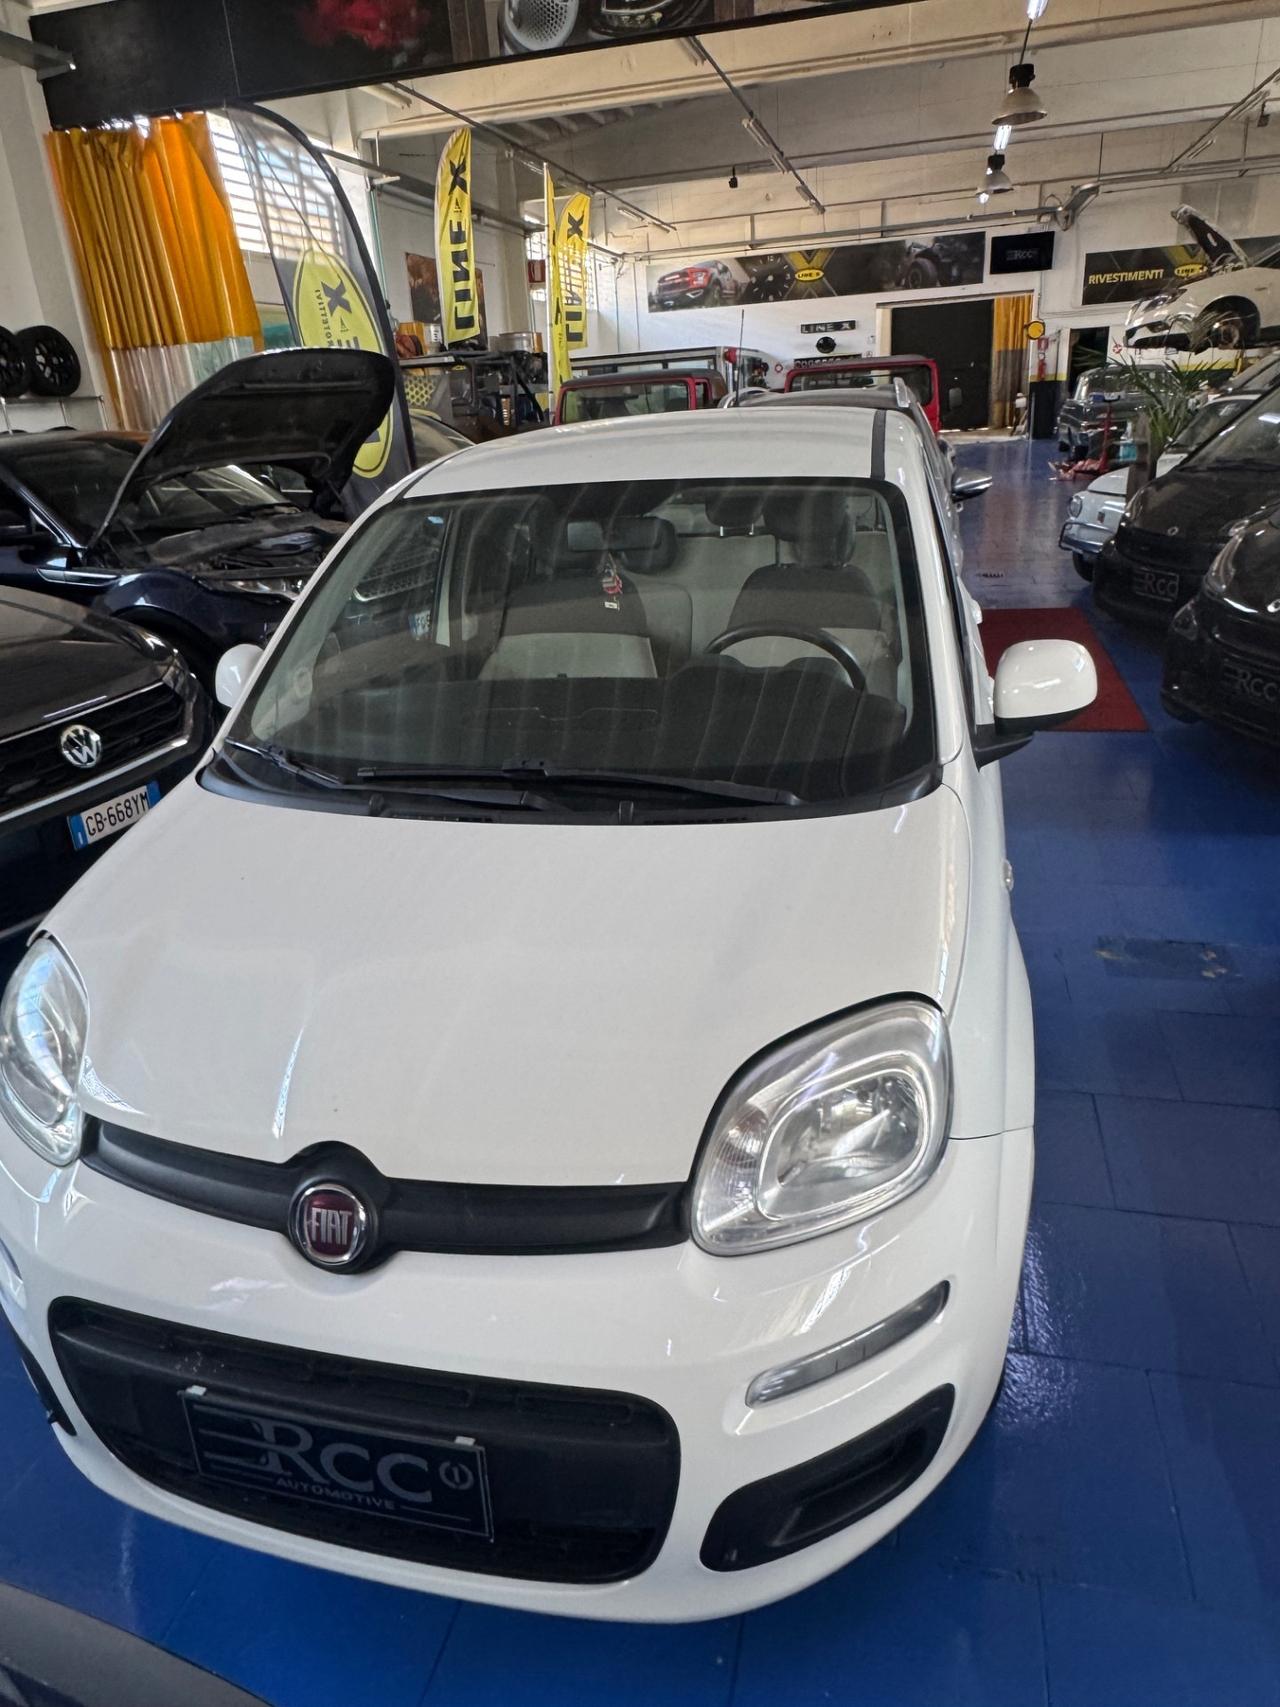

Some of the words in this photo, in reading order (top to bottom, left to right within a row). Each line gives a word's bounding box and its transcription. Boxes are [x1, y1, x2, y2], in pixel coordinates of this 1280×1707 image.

[1088, 269, 1164, 285] RIVESTIMENTI
[802, 322, 834, 334] LINE
[311, 1206, 353, 1245] FIAT
[275, 1476, 396, 1511] AUTOMOTIVE
